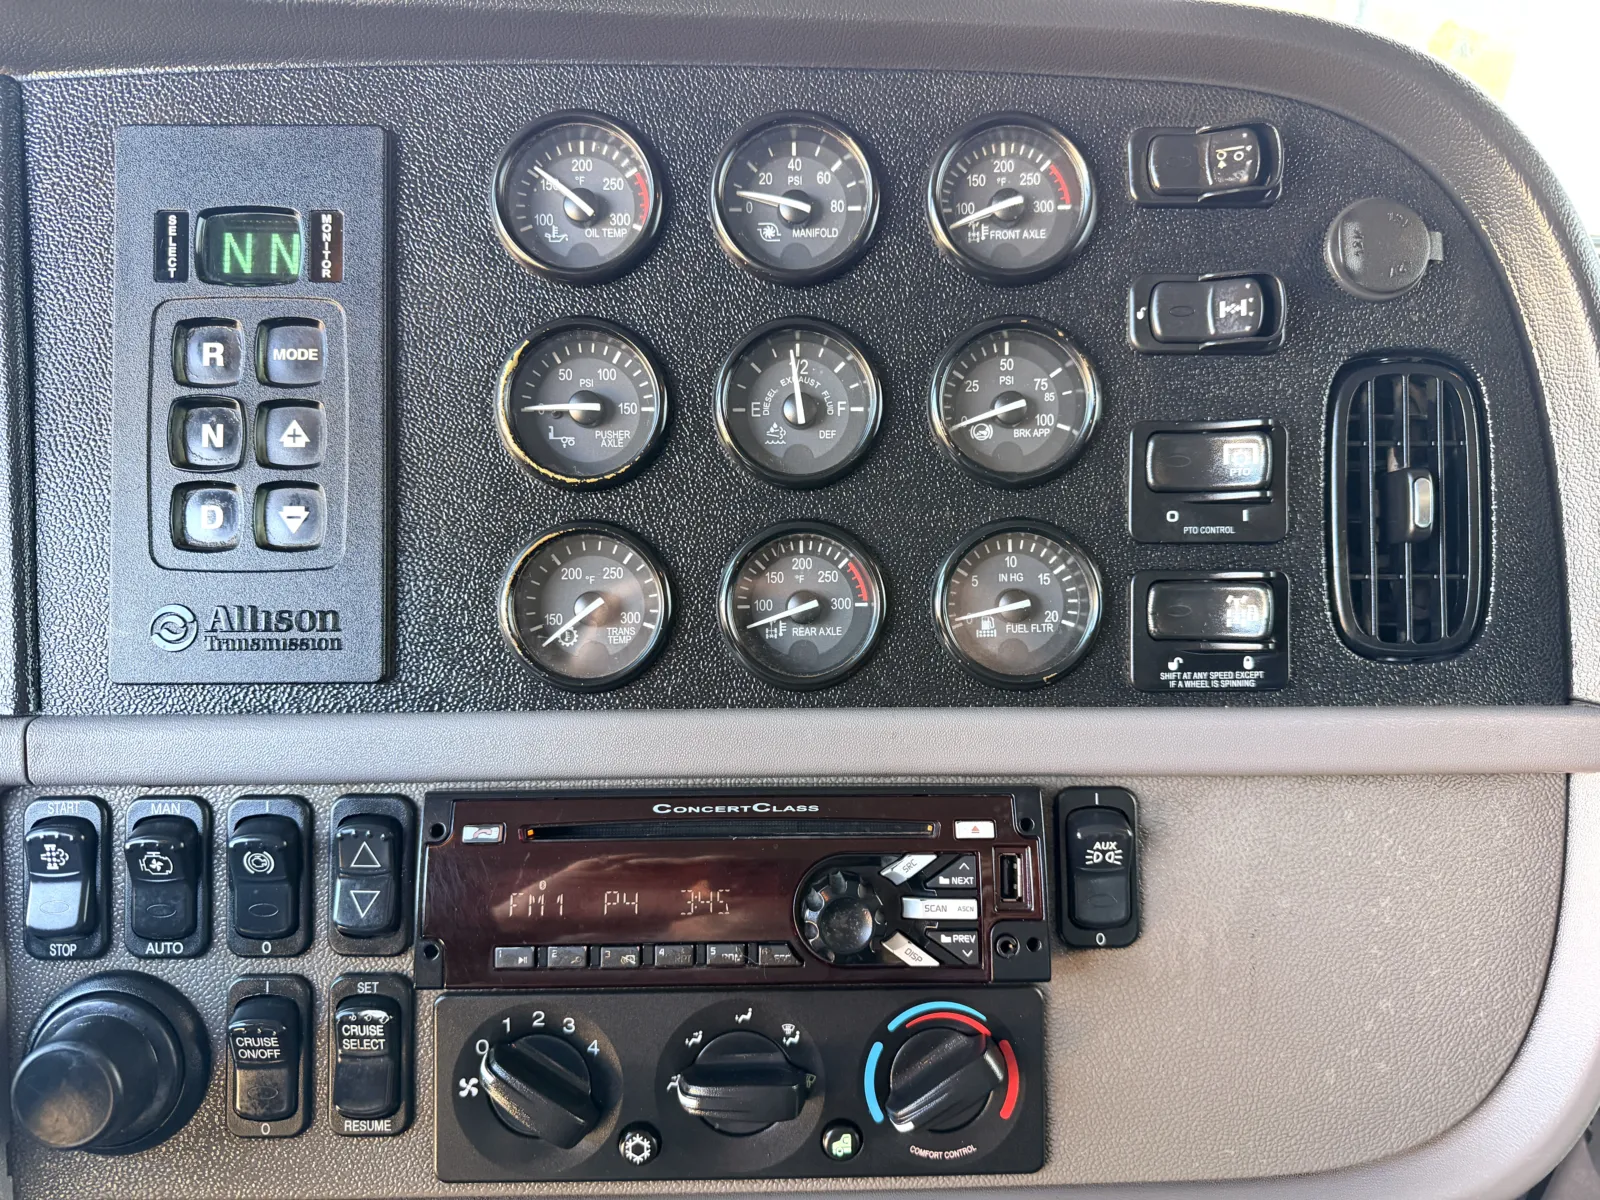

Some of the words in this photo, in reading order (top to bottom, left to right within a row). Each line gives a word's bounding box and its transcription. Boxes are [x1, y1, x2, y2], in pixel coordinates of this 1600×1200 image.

[571, 159, 593, 172] 200
[787, 159, 802, 172] 40
[993, 161, 1015, 173] 200
[602, 178, 624, 191] 250
[758, 173, 773, 185] 20
[787, 176, 803, 186] PSI
[816, 172, 831, 185] 60
[966, 175, 986, 187] 150
[1019, 173, 1041, 186] 250
[745, 202, 753, 214] 0
[830, 200, 845, 213] 80
[955, 203, 976, 215] 100
[1033, 201, 1054, 213] 300
[534, 214, 554, 226] 100
[609, 213, 631, 226] 300
[584, 229, 600, 238] OIL
[602, 228, 628, 238] TEMP
[792, 228, 839, 238] MANIFOLD
[989, 230, 1020, 240] FRONT
[1022, 230, 1047, 239] AXLE
[167, 214, 177, 278] SELECT
[321, 214, 332, 278] MONITOR
[202, 342, 225, 367] R
[273, 348, 319, 361] MODE
[999, 359, 1014, 371] 50
[558, 369, 573, 381] 50
[597, 368, 617, 381] 100
[579, 379, 594, 388] PSI
[965, 379, 980, 392] 25
[999, 376, 1014, 386] PSI
[1033, 378, 1049, 391] 75
[762, 388, 778, 416] DIESEL
[780, 376, 821, 389] EXAUST
[821, 390, 834, 416] FLUID
[1044, 392, 1055, 402] 85
[618, 402, 638, 415] 150
[751, 401, 761, 418] E
[837, 401, 847, 417] F
[1035, 413, 1055, 426] 100
[201, 423, 224, 448] N
[595, 431, 631, 440] PUSHER
[819, 429, 837, 440] DEF
[1013, 428, 1032, 437] BRK
[1033, 428, 1050, 437] APP
[600, 440, 624, 448] AXLE
[1229, 467, 1251, 477] PTO
[201, 504, 224, 530] D
[1183, 526, 1199, 534] PTO
[1200, 526, 1236, 534] CONTROL
[791, 557, 813, 570] 200
[1004, 556, 1018, 568] 10
[561, 567, 583, 580] 200
[602, 567, 624, 579] 250
[765, 571, 784, 584] 150
[817, 570, 839, 583] 250
[998, 573, 1008, 582] IN
[1009, 572, 1024, 582] HG
[971, 575, 979, 587] 5
[1038, 573, 1050, 586] 15
[754, 599, 773, 611] 100
[830, 597, 851, 610] 300
[204, 605, 341, 633] Allison
[544, 613, 563, 626] 150
[620, 612, 641, 624] 300
[1044, 611, 1059, 624] 20
[606, 627, 636, 636] TRANS
[791, 627, 817, 637] REAR
[818, 626, 843, 636] AXLE
[1006, 623, 1029, 633] FUEL
[1031, 623, 1054, 633] FLTR
[203, 635, 342, 651] Transmission
[607, 635, 632, 645] TEMP
[1160, 672, 1181, 680] SHIFT
[1182, 672, 1192, 680] AT
[1193, 671, 1208, 680] ANY
[1209, 671, 1234, 680] SPEED
[1235, 670, 1264, 679] EXCEPT
[1169, 680, 1177, 688] IF
[1177, 680, 1184, 688] A
[1184, 680, 1210, 688] WHEEL
[1211, 680, 1219, 688] IS
[1220, 680, 1256, 688] SPINNING
[47, 802, 79, 813] START
[151, 803, 181, 814] MAN
[1093, 841, 1118, 850] AUX
[902, 858, 918, 873] SRC
[951, 876, 974, 885] NEXT
[604, 890, 639, 915] P4
[924, 904, 948, 913] SCAN
[957, 905, 975, 913] ASCN
[952, 934, 976, 944] PREV
[49, 943, 77, 957] STOP
[145, 942, 183, 954] AUTO
[551, 950, 558, 958] 2
[604, 950, 611, 958] 3
[659, 948, 665, 957] 4
[710, 947, 717, 955] 5
[904, 947, 923, 963] DISP
[357, 982, 379, 994] SET
[502, 1017, 511, 1033] 1
[532, 1011, 546, 1027] 2
[341, 1025, 385, 1036] CRUISE
[562, 1018, 576, 1034] 3
[235, 1037, 280, 1048] CRUISE
[342, 1039, 386, 1050] SELECT
[475, 1039, 490, 1055] 0
[587, 1039, 600, 1056] 4
[238, 1049, 281, 1059] ON/OFF
[344, 1120, 392, 1132] RESUME
[909, 1145, 943, 1160] COMFORT
[944, 1144, 977, 1159] CONTROL
